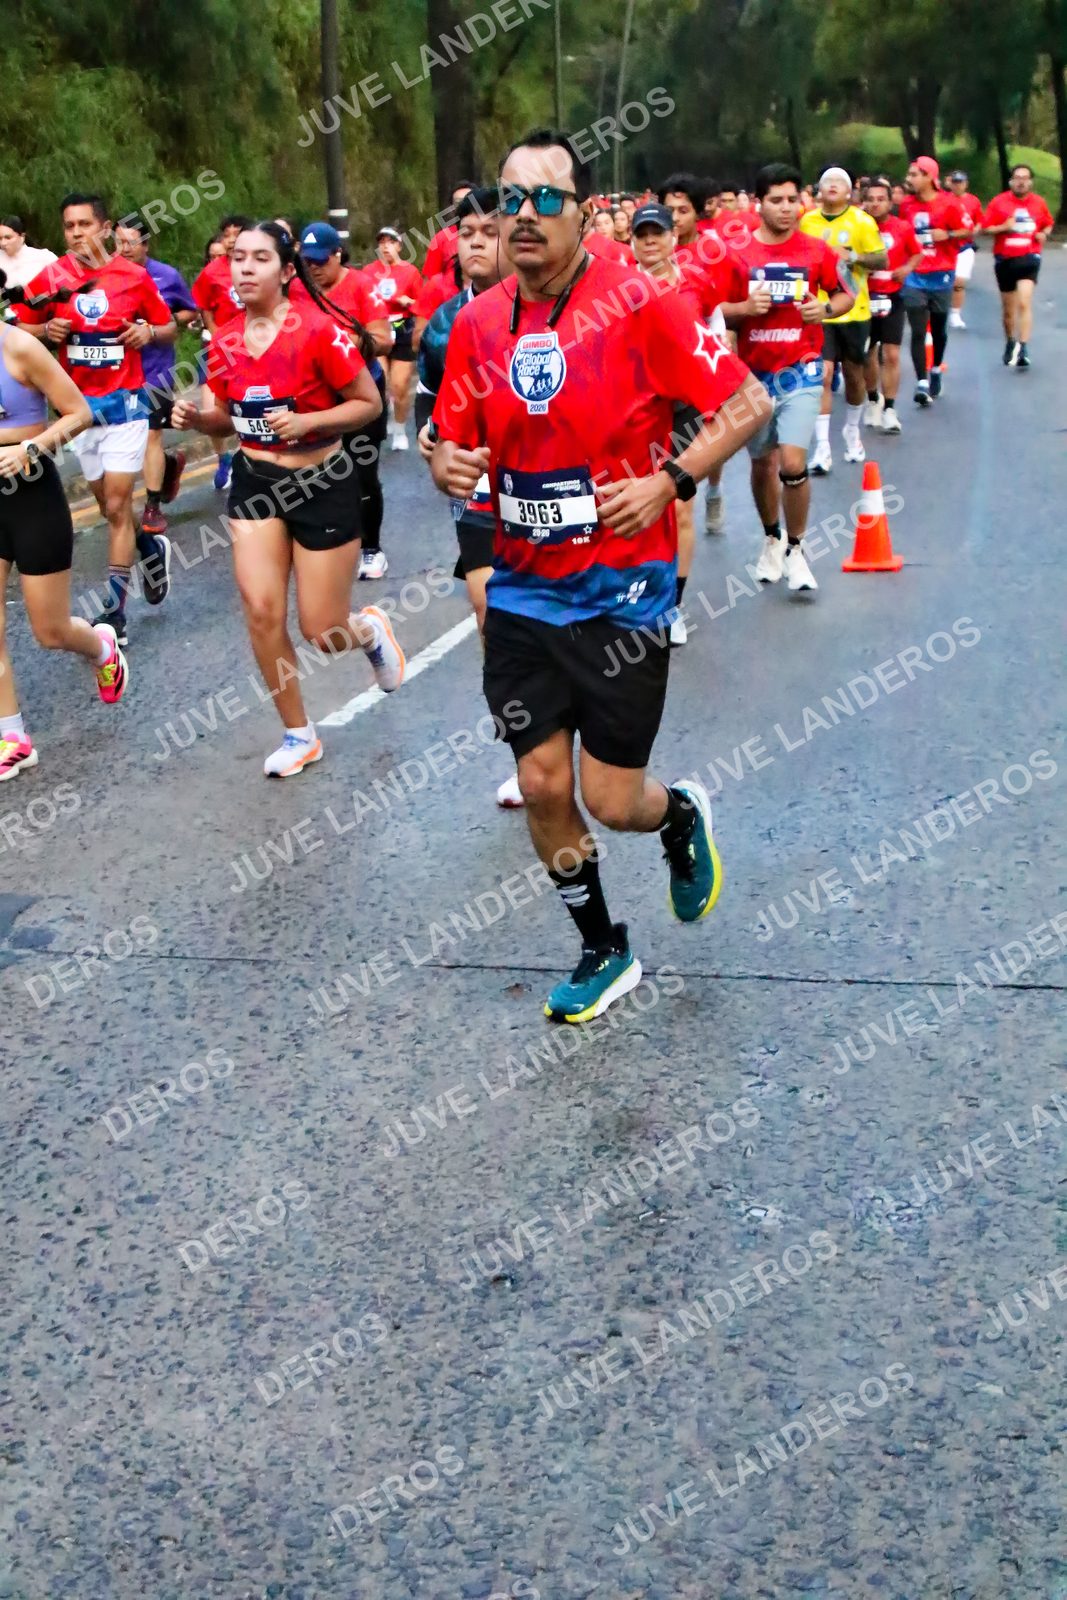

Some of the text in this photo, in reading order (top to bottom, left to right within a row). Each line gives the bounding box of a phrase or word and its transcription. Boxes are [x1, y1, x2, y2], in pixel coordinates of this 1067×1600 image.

[522, 340, 552, 349] BIMBO
[83, 347, 108, 359] 5275
[523, 351, 551, 365] Global
[518, 365, 540, 377] Race
[530, 403, 547, 412] 2026
[248, 419, 275, 433] 549
[518, 501, 563, 525] 3963
[572, 536, 590, 544] 10K
